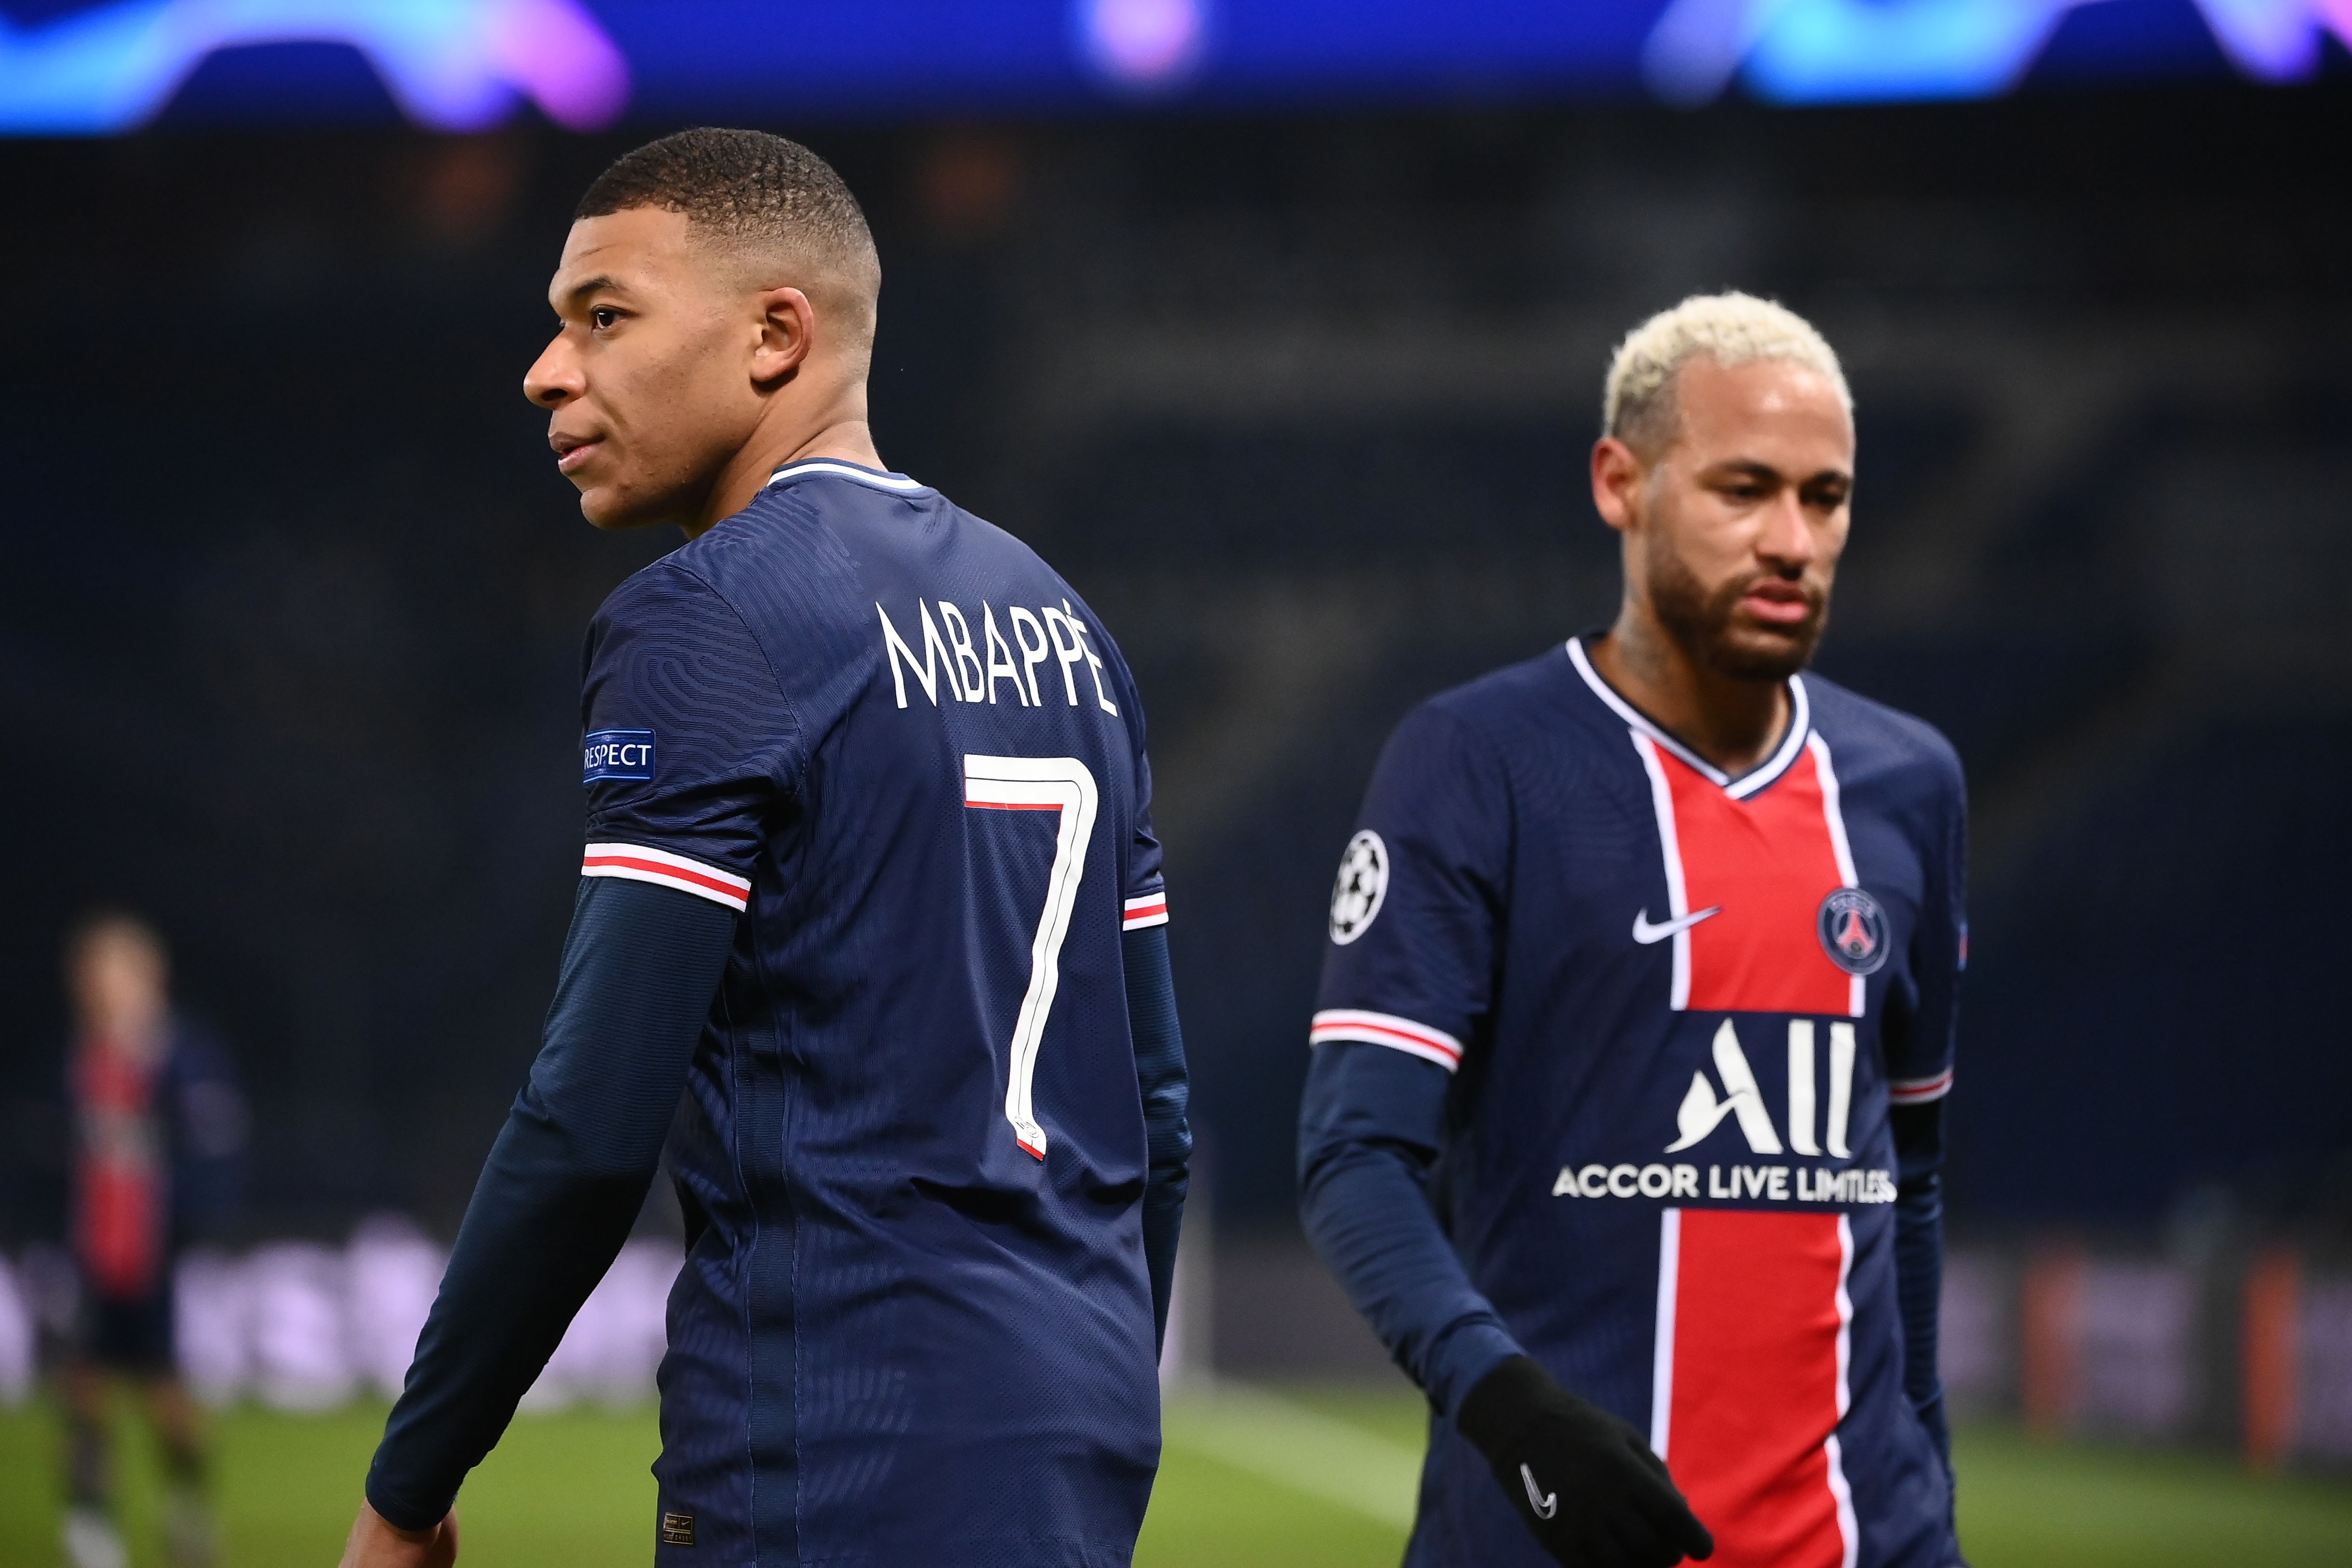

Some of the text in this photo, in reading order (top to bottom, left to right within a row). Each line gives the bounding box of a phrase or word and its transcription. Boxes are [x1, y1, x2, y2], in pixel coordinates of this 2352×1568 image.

[876, 597, 1117, 717] MBAPPÉ
[585, 744, 651, 769] RESPECT
[964, 754, 1099, 1161] 7
[1552, 1164, 1699, 1198] ACCOR
[1709, 1166, 1789, 1200] LIVE
